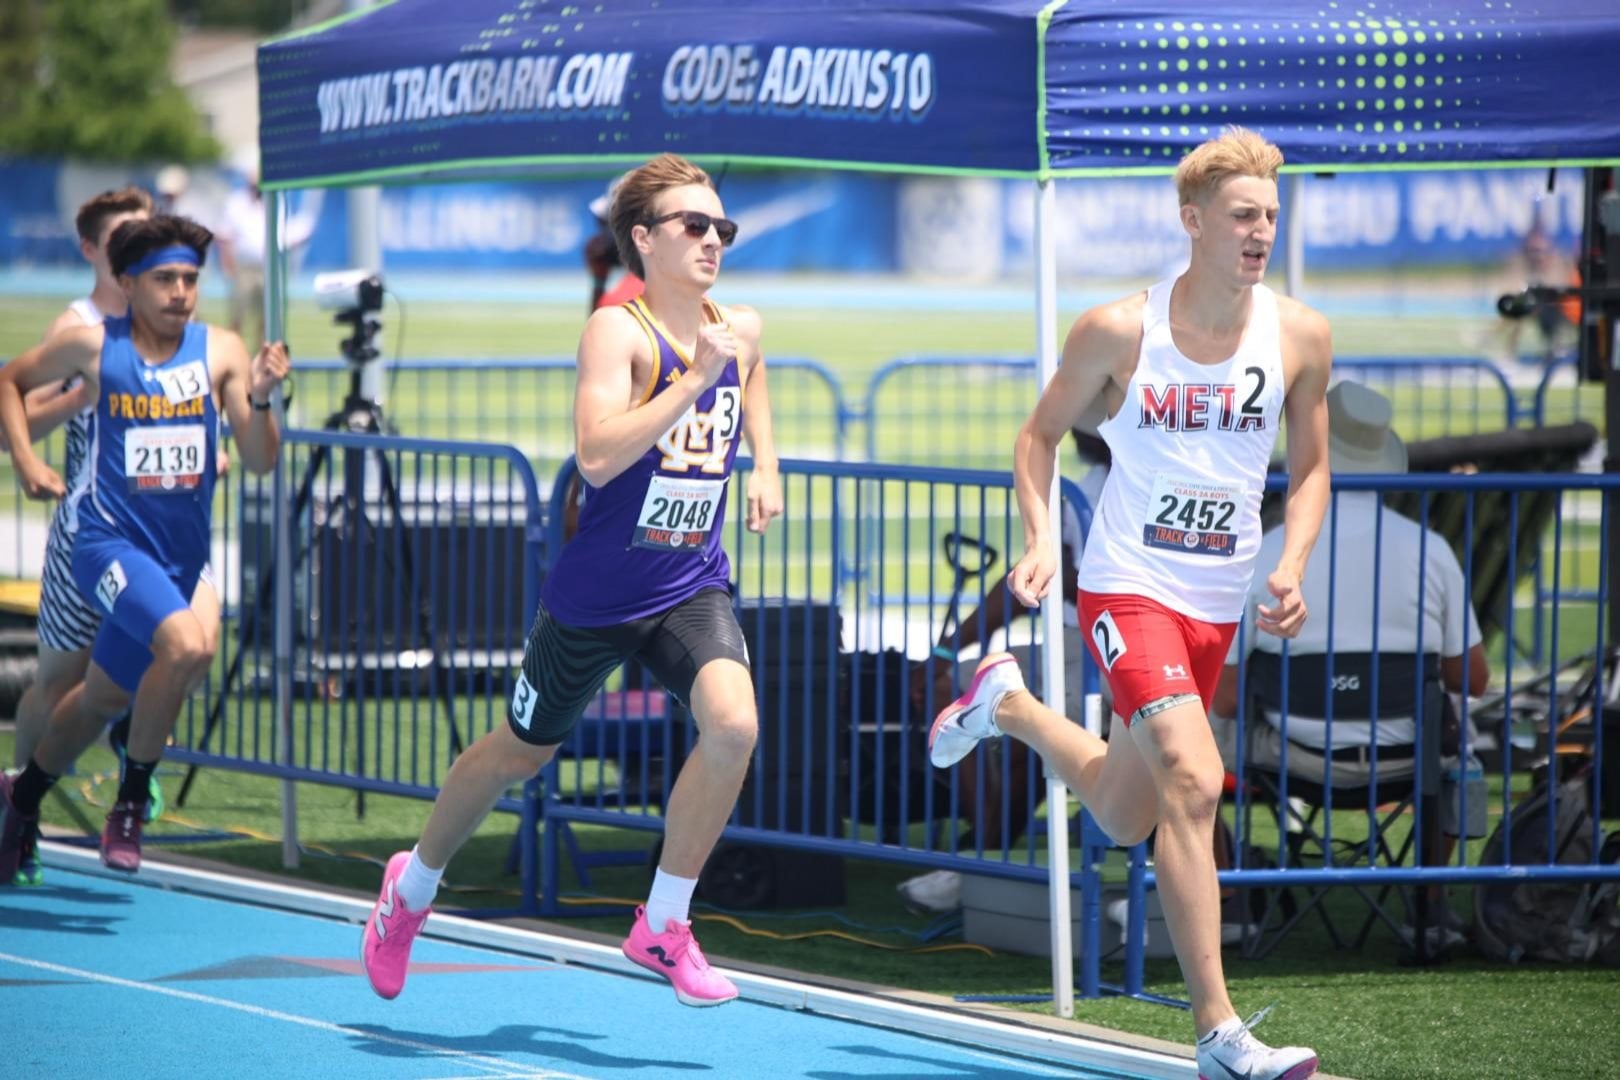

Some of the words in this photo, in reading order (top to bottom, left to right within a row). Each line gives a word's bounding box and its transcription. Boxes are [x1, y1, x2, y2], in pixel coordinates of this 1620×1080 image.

[317, 52, 634, 133] WWW.TRACKBARN.COM
[662, 45, 760, 102] CODE:
[758, 46, 932, 112] ADKINS10
[168, 368, 201, 399] 13
[1241, 366, 1266, 414] 2
[720, 391, 735, 438] 3
[135, 445, 198, 474] 2139
[646, 497, 712, 530] 2048
[1155, 494, 1236, 531] 2452
[1154, 527, 1184, 543] TRACK
[1204, 533, 1229, 548] FIELD
[100, 570, 119, 604] 13
[1095, 620, 1119, 667] 2
[514, 679, 530, 720] 3
